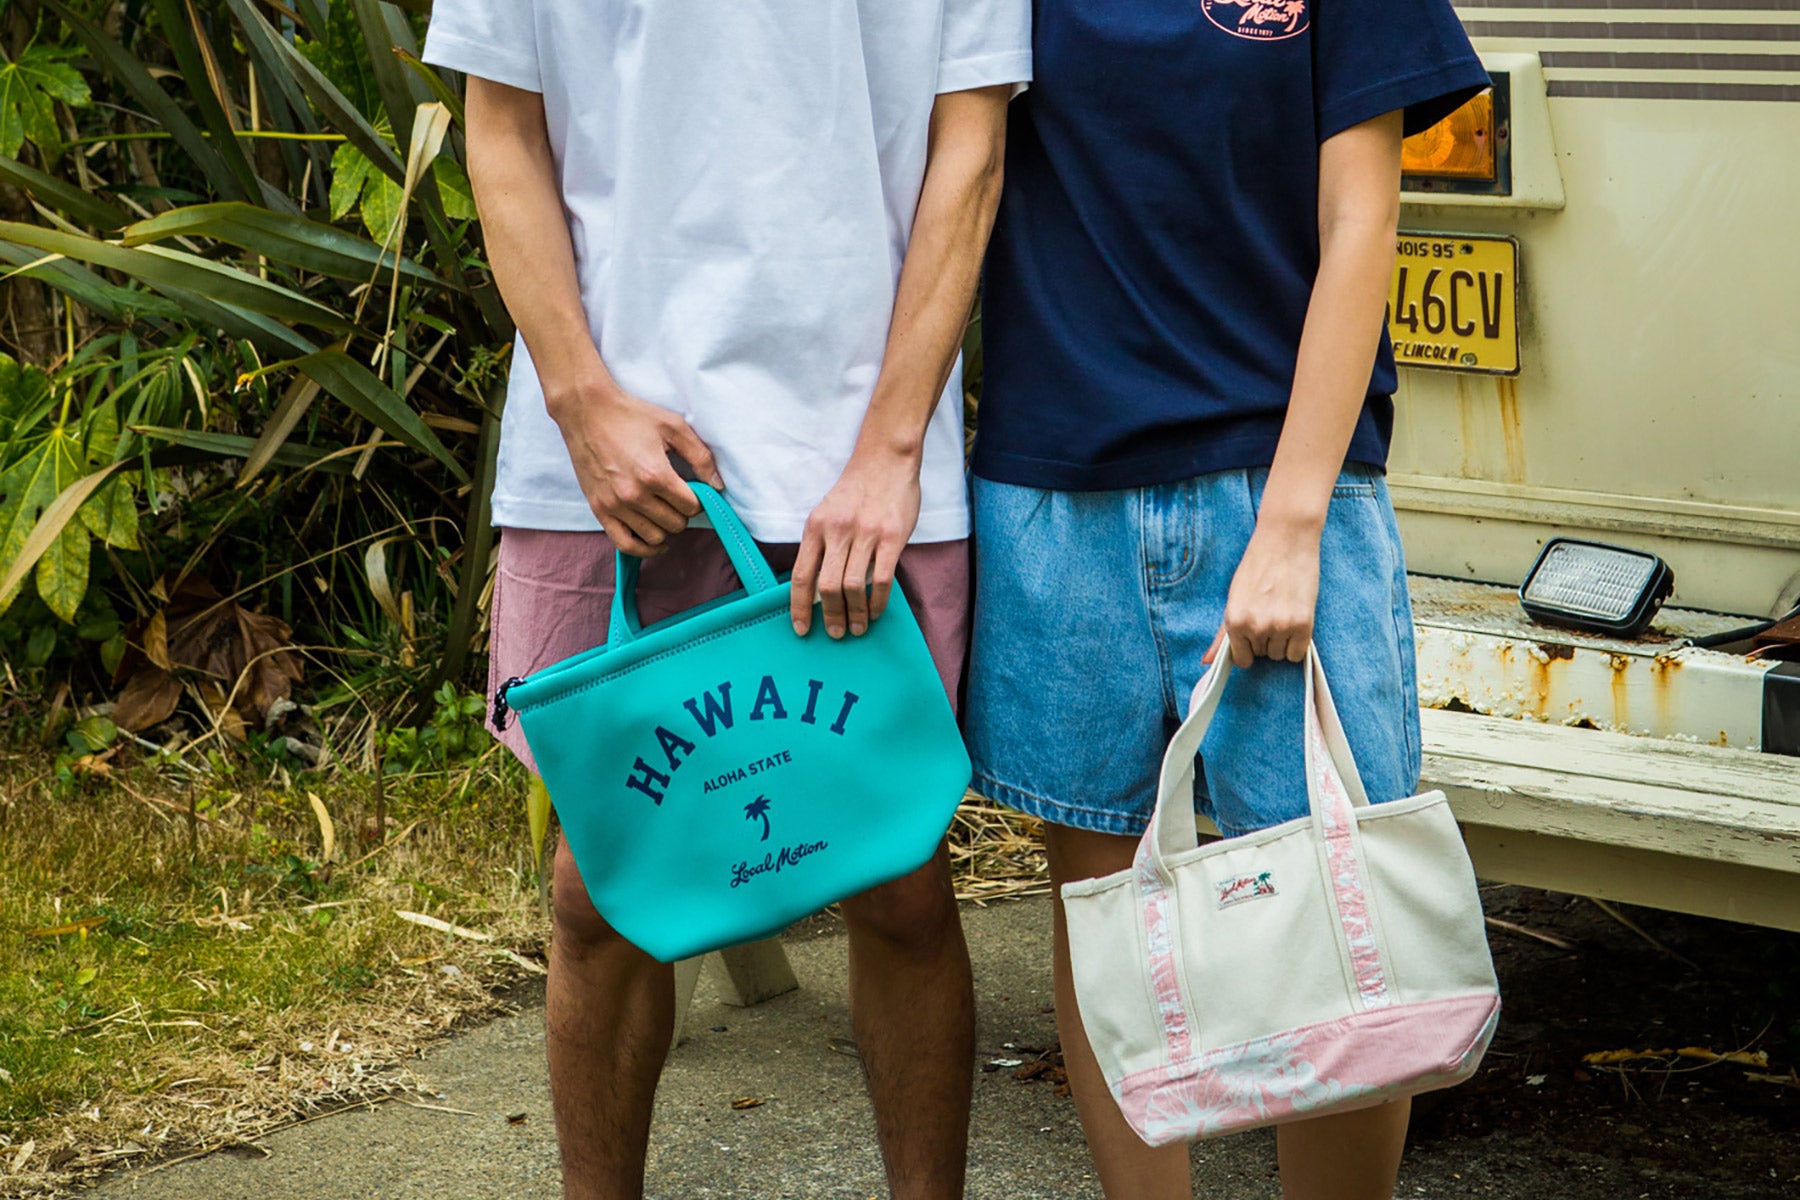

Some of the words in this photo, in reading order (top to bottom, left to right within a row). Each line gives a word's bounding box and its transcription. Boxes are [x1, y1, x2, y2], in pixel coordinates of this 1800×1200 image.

[1238, 2, 1290, 25] Motion
[1432, 243, 1454, 258] 95
[1386, 266, 1502, 339] 46CV
[1403, 344, 1459, 361] LINCOLN
[625, 675, 860, 807] HAWAII
[703, 767, 747, 794] ALOHA
[748, 750, 793, 776] STATE
[730, 852, 776, 888] Local
[775, 839, 828, 873] Motion
